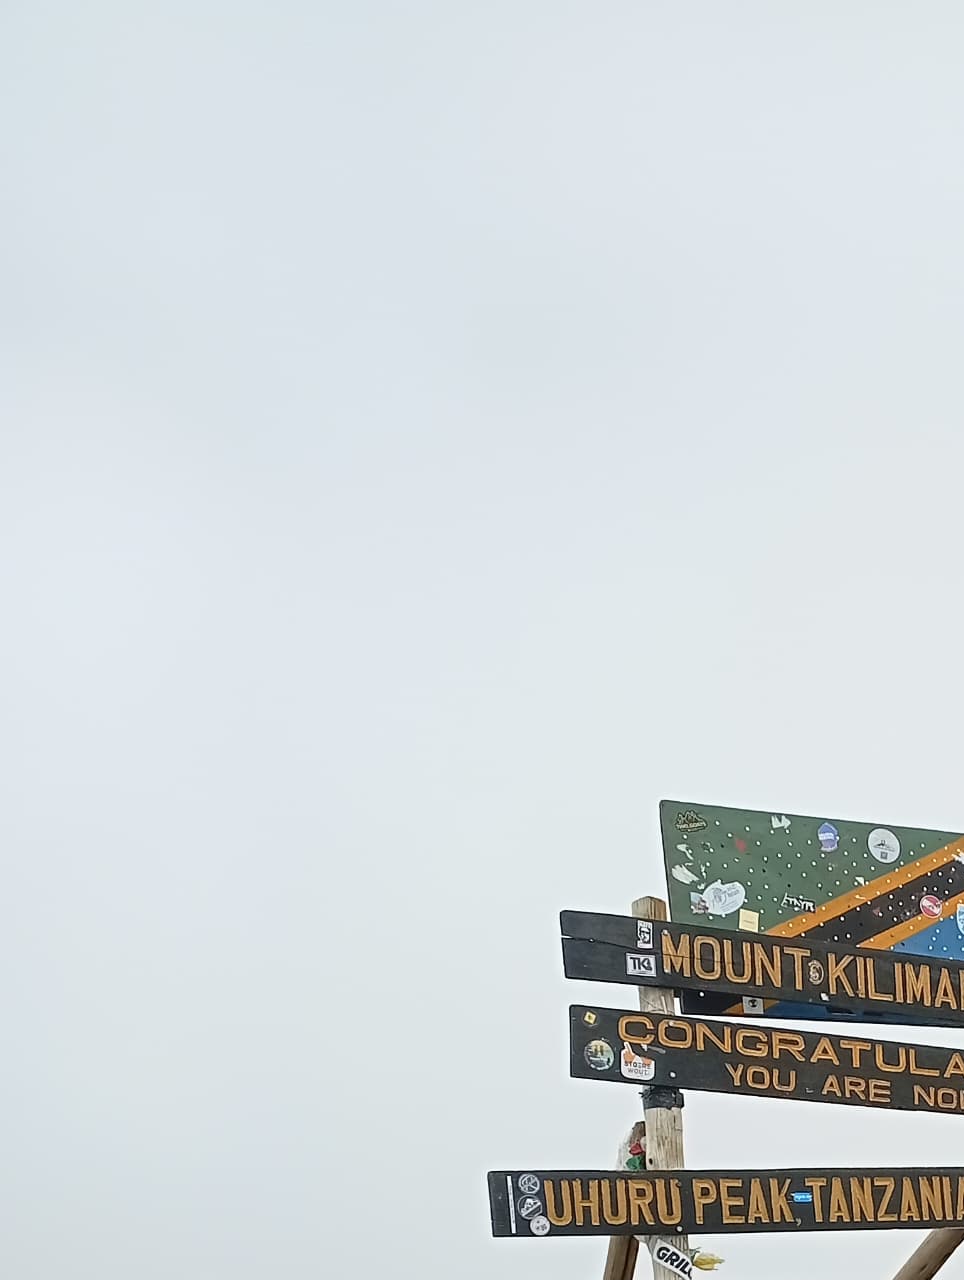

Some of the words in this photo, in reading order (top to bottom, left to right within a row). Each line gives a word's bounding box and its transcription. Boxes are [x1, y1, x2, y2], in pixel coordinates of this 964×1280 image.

[661, 931, 811, 991] MOUNT
[725, 1062, 798, 1092] YOU
[821, 1074, 892, 1103] ARE
[543, 1178, 682, 1226] UHURU
